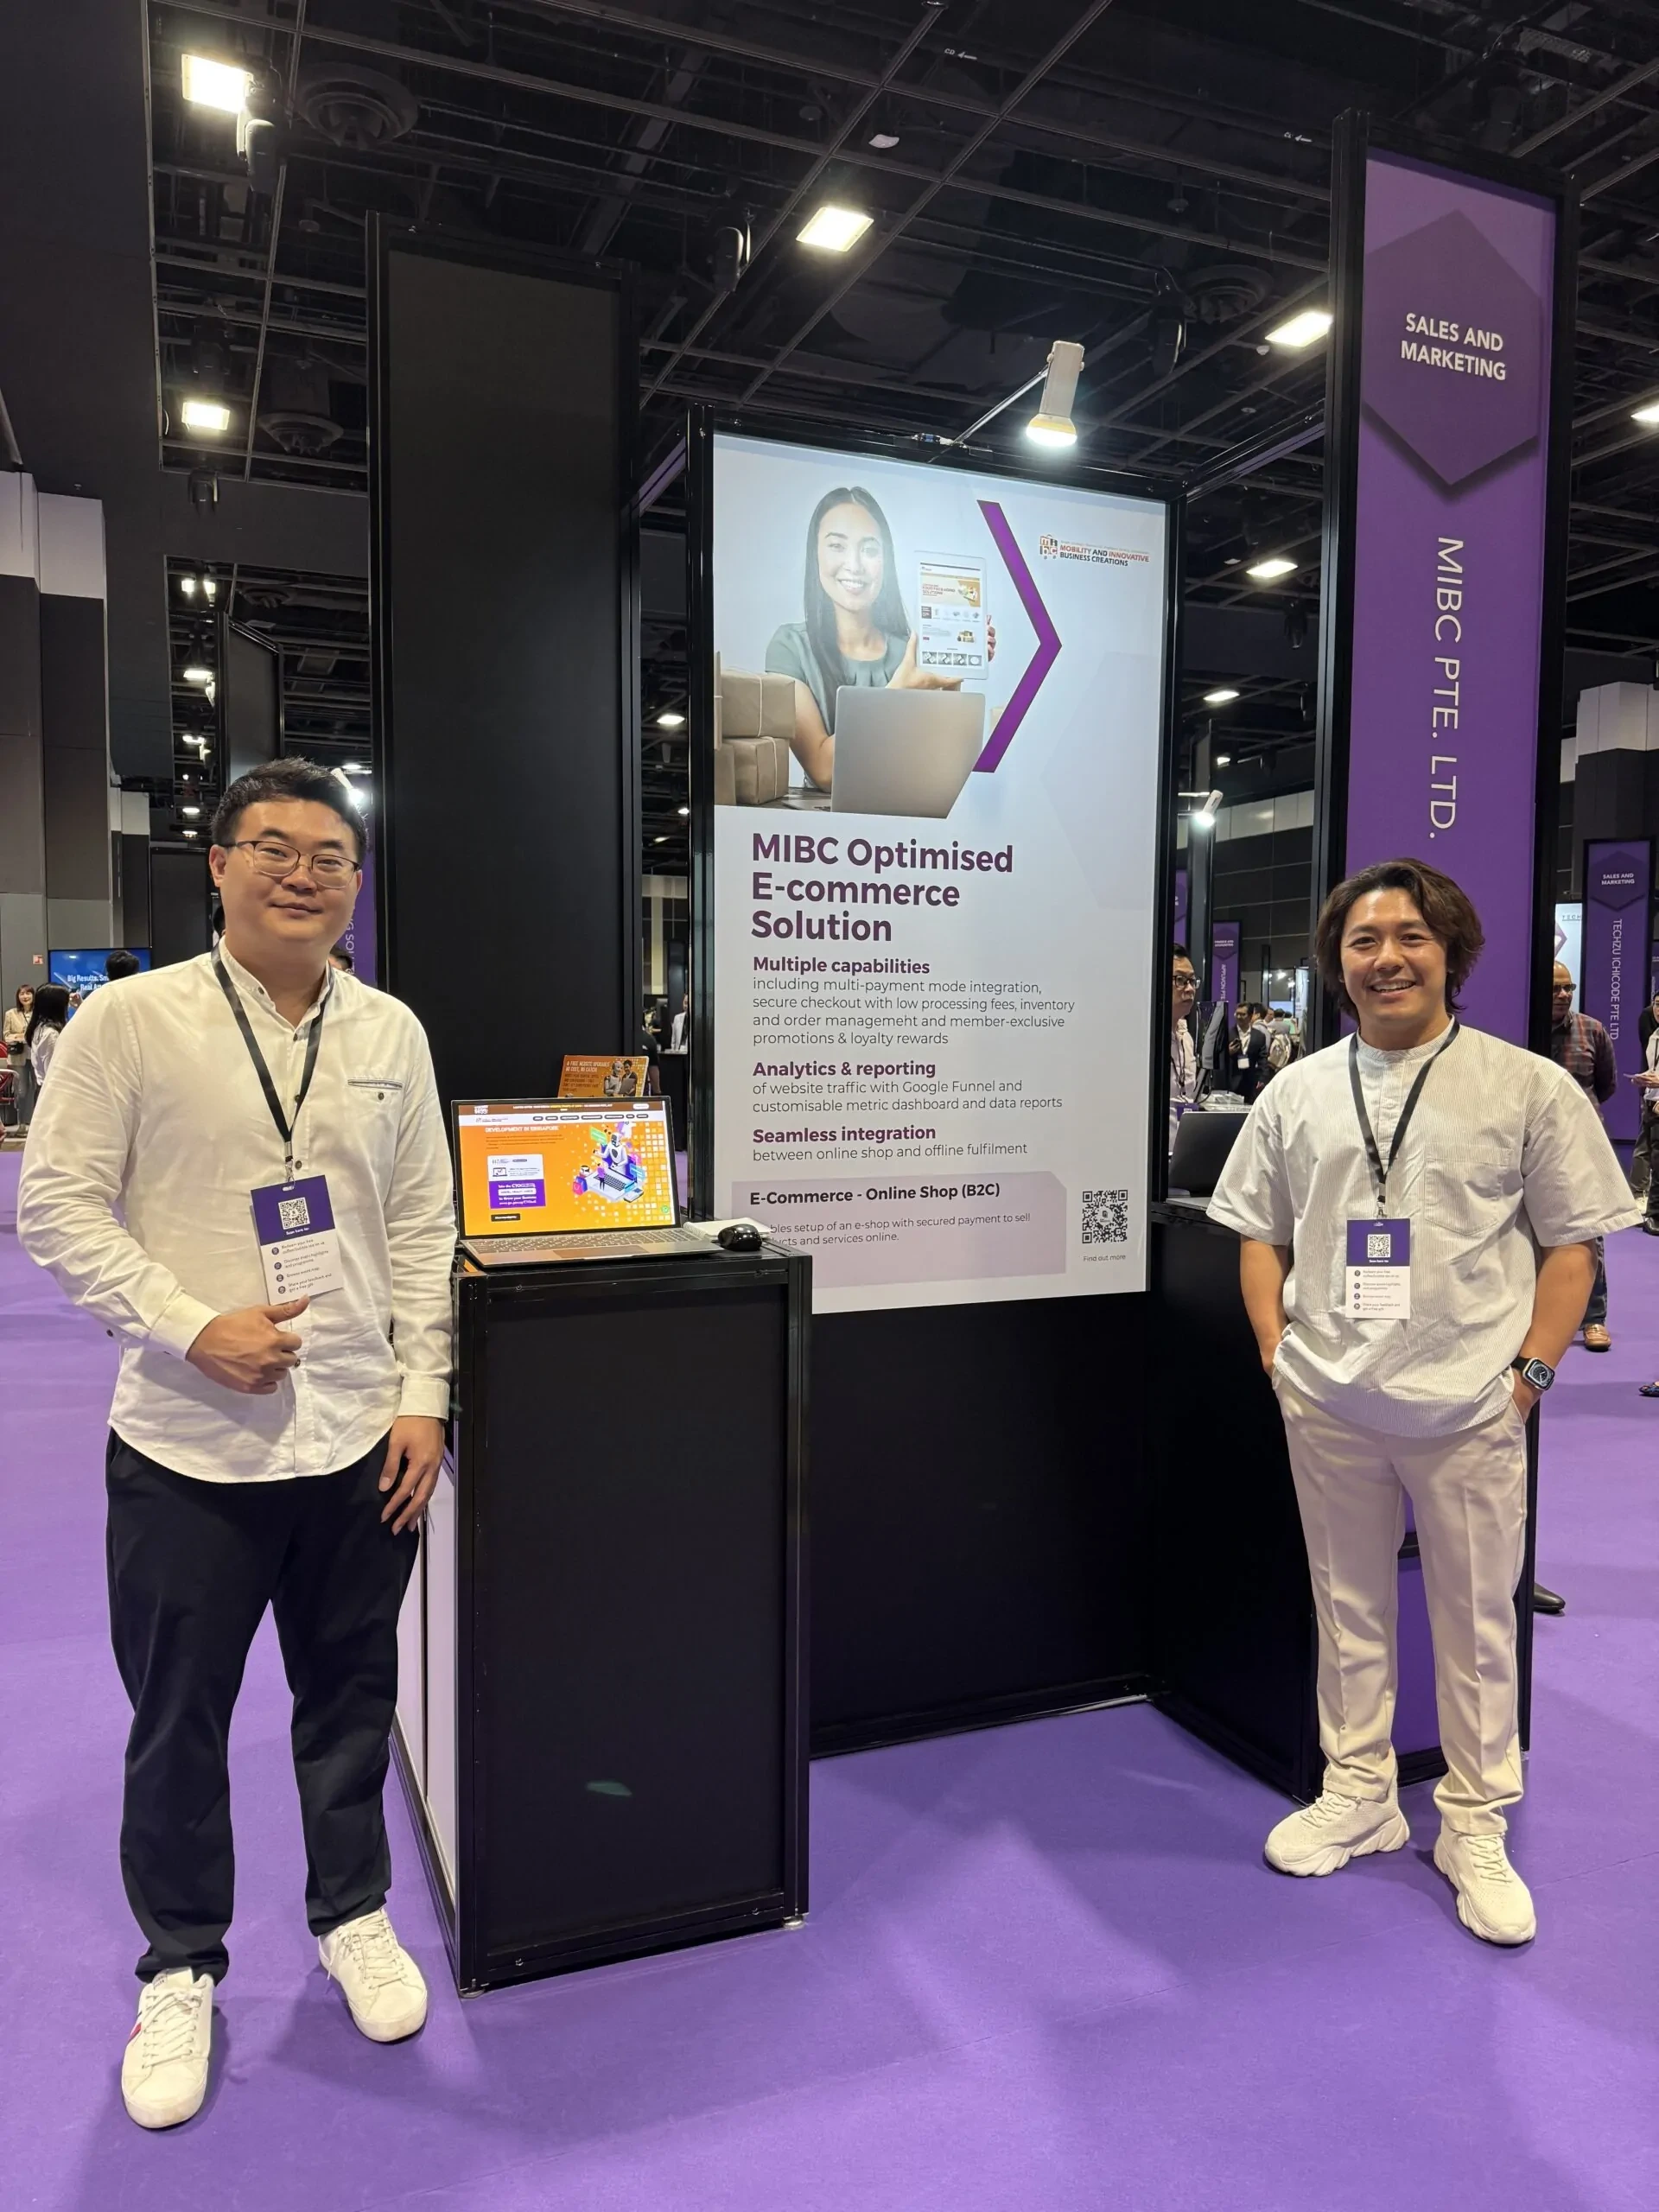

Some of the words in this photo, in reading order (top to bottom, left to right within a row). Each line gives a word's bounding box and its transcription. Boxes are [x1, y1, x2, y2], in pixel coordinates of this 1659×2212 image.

[1406, 313, 1459, 342] SALES
[1463, 327, 1503, 352] AND
[1401, 340, 1506, 380] MARKETING
[1059, 544, 1091, 555] MOBILITY
[1092, 549, 1107, 557] AND
[1109, 551, 1149, 563] INNOVATIVE
[1059, 551, 1090, 562] BUSINESS
[1091, 556, 1128, 567] CREATIONS
[1433, 537, 1465, 643] MIBC
[1432, 657, 1460, 739] PTE.
[1429, 755, 1458, 839] LTD.
[753, 833, 839, 865] MIBC
[847, 838, 1013, 874] Optimised
[753, 872, 960, 907] E-commerce
[751, 910, 892, 942] Solution
[1612, 918, 1623, 955] TECHZU
[753, 956, 827, 976] Multiple
[831, 958, 930, 976] capabilities
[753, 977, 819, 993] including
[823, 978, 925, 994] multi-payment
[929, 981, 966, 992] mode
[969, 981, 1042, 995] integration,
[1611, 957, 1621, 1002] ICHICODE
[753, 998, 797, 1007] secure
[801, 996, 861, 1008] checkout
[865, 996, 893, 1008] with
[896, 997, 918, 1009] low
[922, 998, 987, 1012] processing
[991, 998, 1017, 1012] fees,
[1020, 999, 1075, 1013] inventory
[1610, 1004, 1620, 1021] PTE
[753, 1014, 779, 1026] and
[784, 1014, 821, 1026] order
[921, 1015, 946, 1027] and
[950, 1015, 1065, 1027] member-exclusive
[753, 1032, 834, 1046] promotions
[838, 1033, 847, 1044] &
[851, 1032, 893, 1046] loyalty
[897, 1033, 948, 1044] rewards
[1610, 1023, 1619, 1040] LTD
[753, 1060, 836, 1079] Analytics
[841, 1062, 852, 1075] &
[856, 1060, 936, 1078] reporting
[753, 1082, 766, 1094] of
[770, 1082, 823, 1094] website
[827, 1082, 867, 1093] traffic
[870, 1081, 899, 1093] with
[902, 1081, 948, 1095] Google
[952, 1079, 995, 1091] Funnel
[999, 1080, 1022, 1091] and
[753, 1099, 842, 1112] customisable
[847, 1099, 888, 1110] metric
[892, 1097, 958, 1109] dashboard
[963, 1097, 986, 1109] and
[989, 1097, 1016, 1109] data
[1020, 1097, 1063, 1109] reports
[753, 1128, 836, 1143] Seamless
[842, 1125, 936, 1144] integration
[753, 1149, 812, 1161] between
[817, 1147, 858, 1160] online
[861, 1147, 893, 1160] shop
[897, 1145, 920, 1157] and
[925, 1144, 963, 1157] offline
[967, 1143, 1027, 1155] fulfilment
[750, 1191, 853, 1205] E-Commerce
[866, 1186, 916, 1200] Online
[919, 1185, 958, 1200] Shop
[962, 1183, 1000, 1198] (B2C)
[794, 1223, 823, 1235] setup
[827, 1222, 837, 1230] of
[839, 1222, 852, 1230] an
[855, 1219, 889, 1230] e-shop
[892, 1217, 914, 1228] with
[916, 1216, 956, 1227] secured
[958, 1214, 1001, 1227] payment
[1003, 1214, 1013, 1223] to
[1014, 1213, 1031, 1222] sell
[800, 1236, 820, 1245] and
[823, 1234, 863, 1244] services
[866, 1232, 899, 1243] online.
